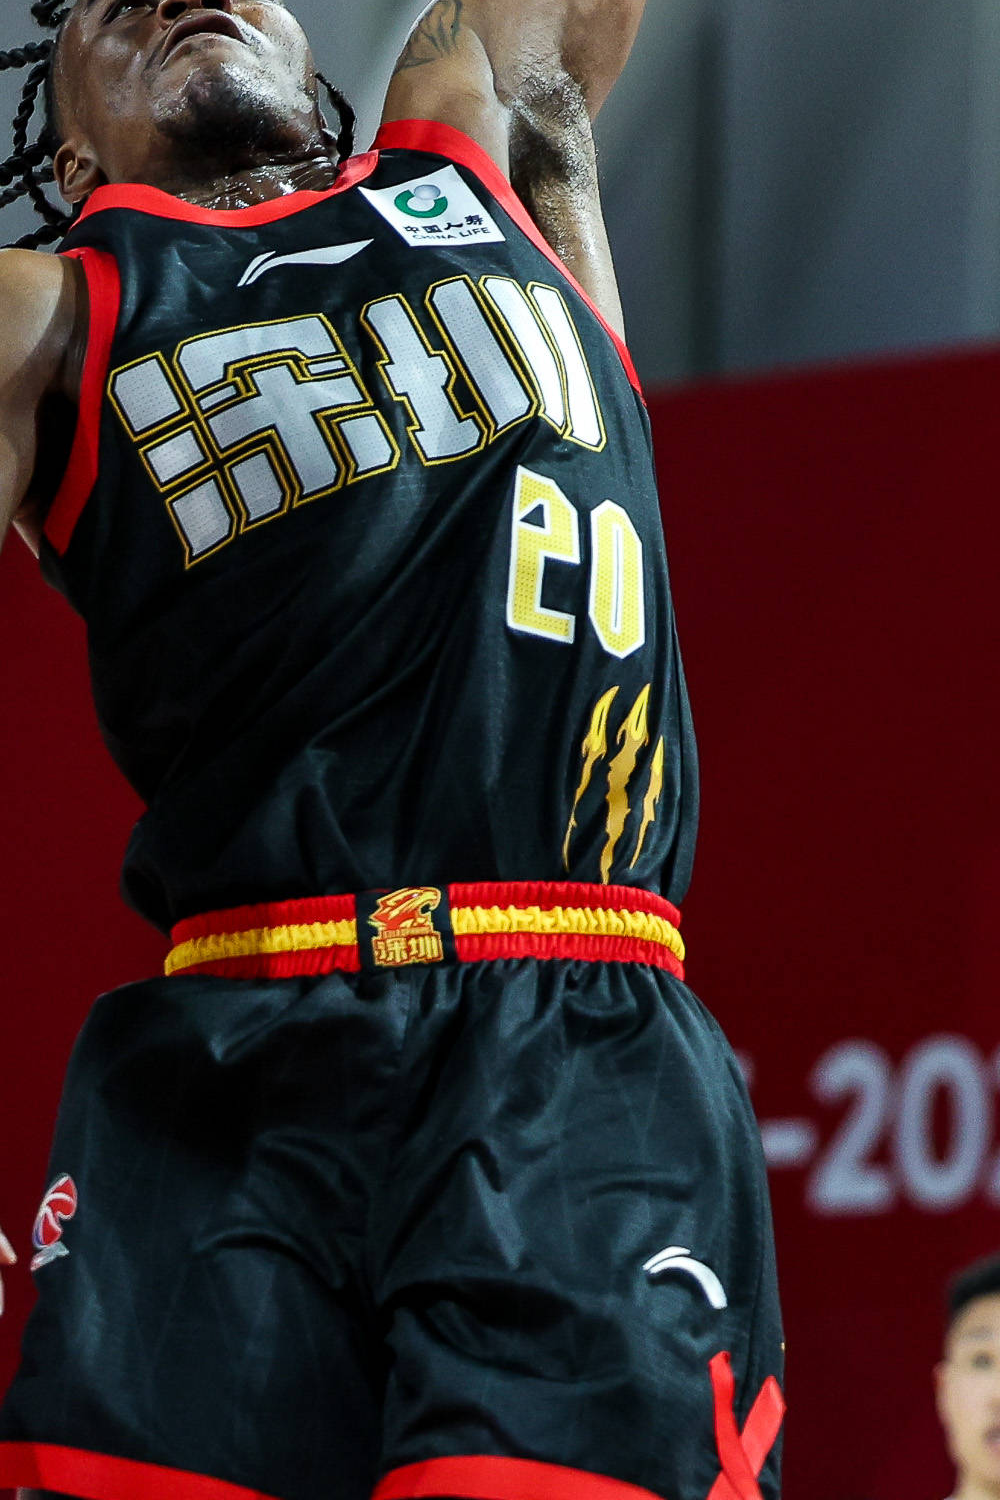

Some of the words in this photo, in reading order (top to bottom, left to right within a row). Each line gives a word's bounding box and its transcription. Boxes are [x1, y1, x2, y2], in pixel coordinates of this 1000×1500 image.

[404, 214, 484, 234] 中国人寿
[412, 233, 457, 241] CHINA
[460, 226, 492, 238] LIFE
[107, 274, 606, 570] 深圳
[506, 464, 646, 659] 20
[374, 934, 442, 964] 深圳
